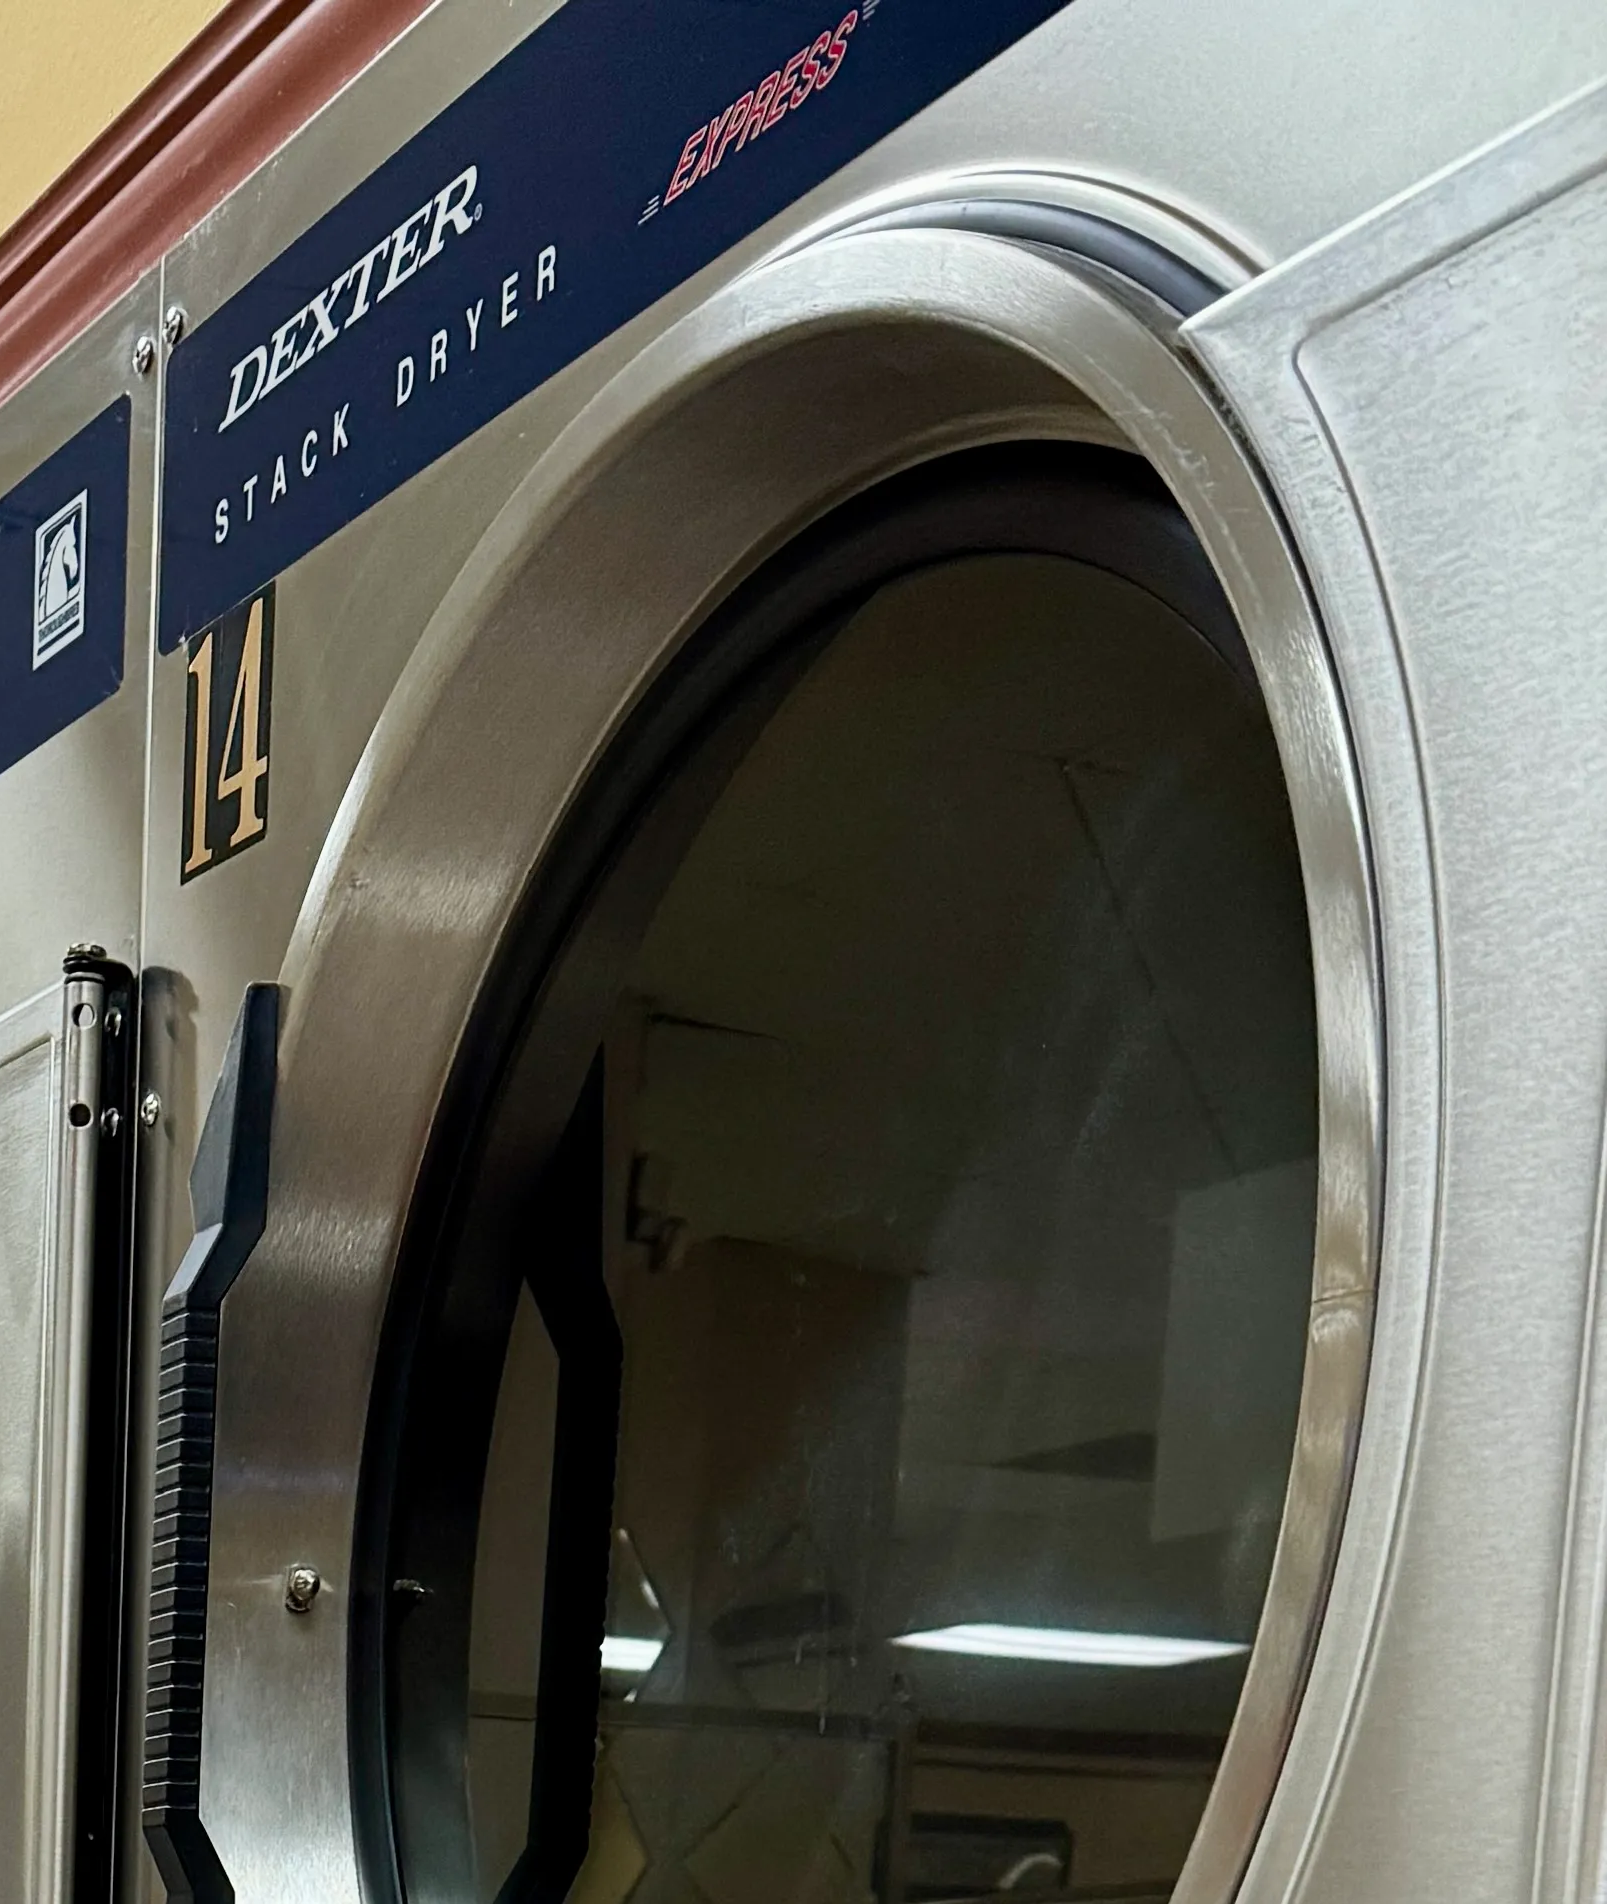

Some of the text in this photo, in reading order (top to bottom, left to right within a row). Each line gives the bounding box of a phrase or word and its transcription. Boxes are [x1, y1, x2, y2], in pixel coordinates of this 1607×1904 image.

[663, 9, 858, 207] EXPRESS
[215, 244, 557, 543] STACK DRYER
[219, 164, 478, 432] DEXTER
[185, 597, 267, 874] 14
